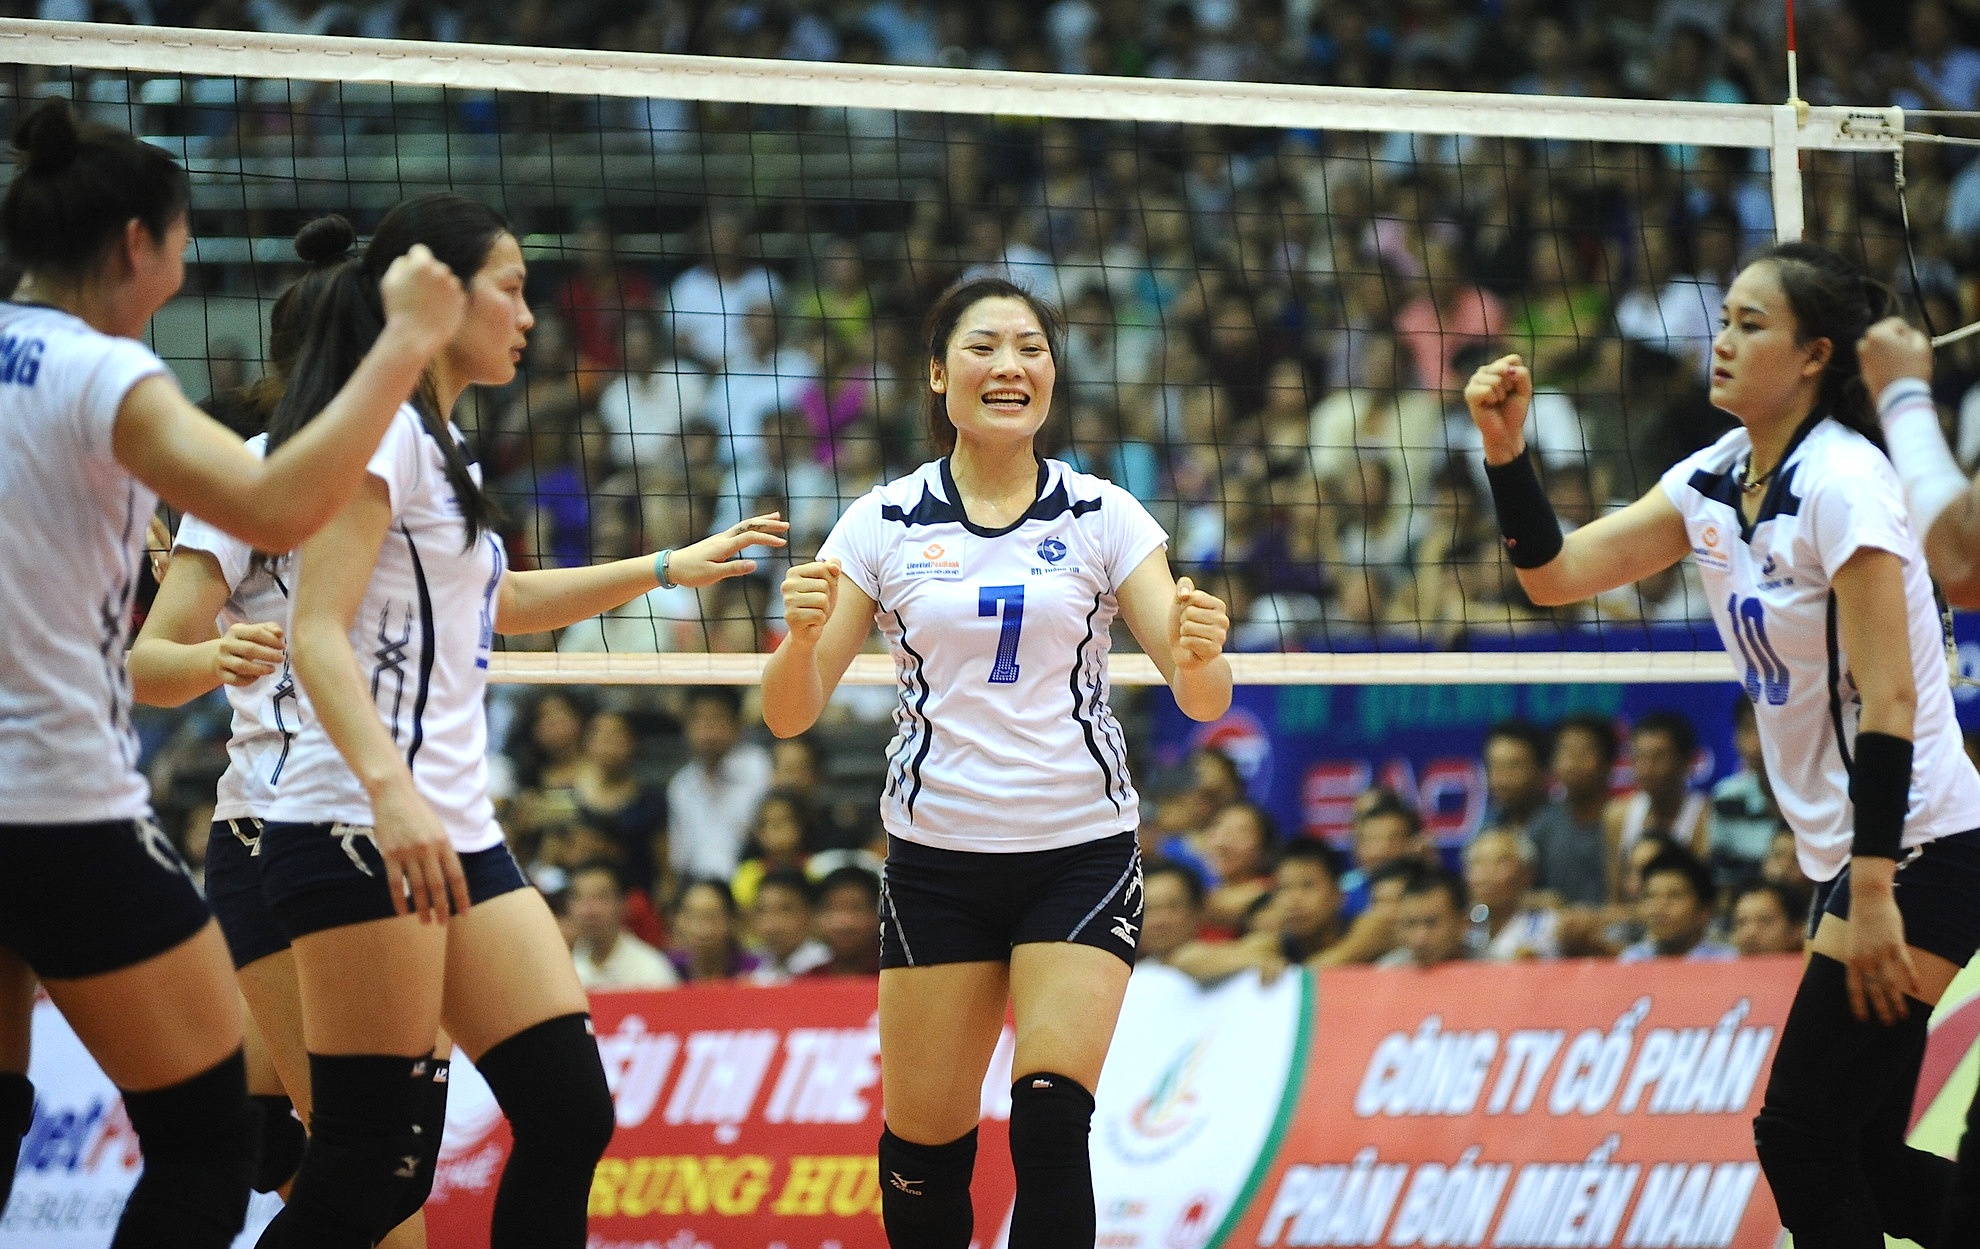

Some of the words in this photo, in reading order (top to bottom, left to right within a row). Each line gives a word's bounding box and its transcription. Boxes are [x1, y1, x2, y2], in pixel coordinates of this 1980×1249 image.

[978, 584, 1025, 684] 7
[1728, 592, 1790, 705] 10
[1352, 1013, 1500, 1118] CÔNG
[1484, 1028, 1566, 1116] TY
[586, 1154, 774, 1216] RUNG
[1255, 1145, 1408, 1248] PHÂN
[1388, 1144, 1512, 1248] BÓN
[1622, 1161, 1763, 1248] NAM
